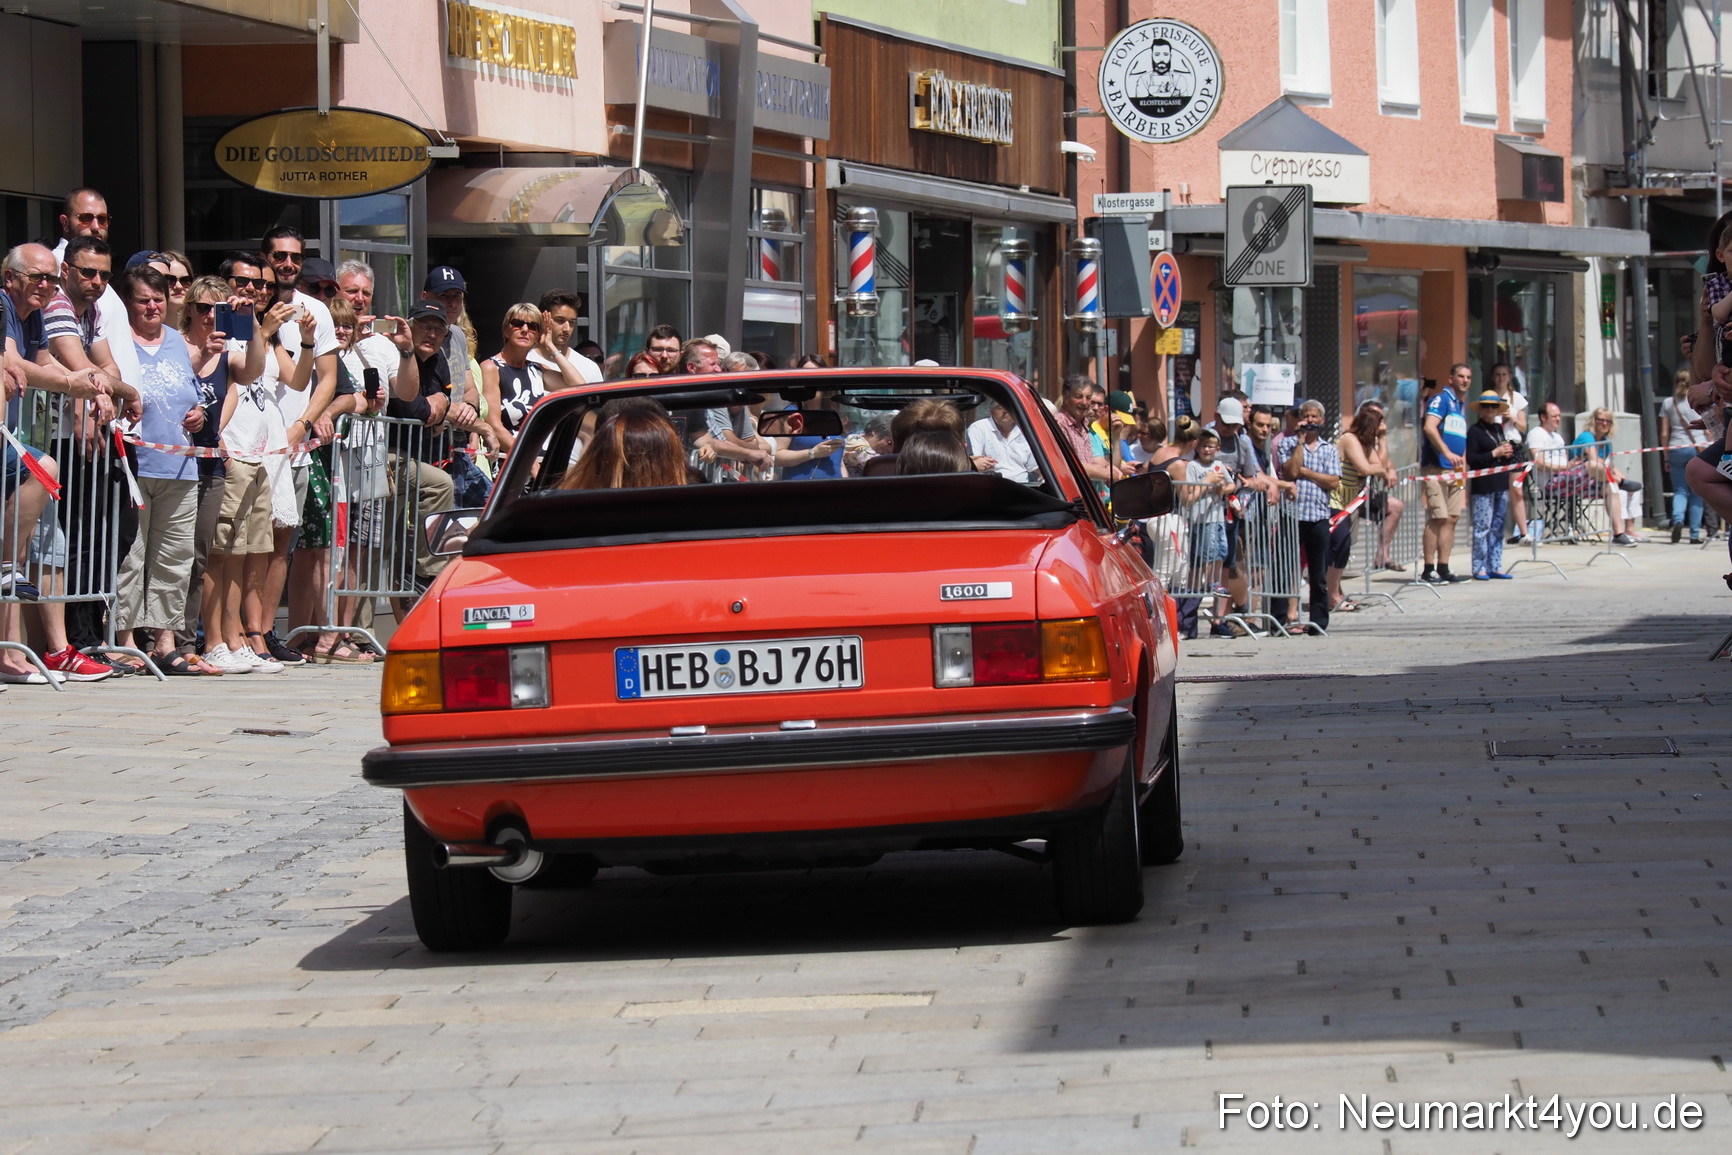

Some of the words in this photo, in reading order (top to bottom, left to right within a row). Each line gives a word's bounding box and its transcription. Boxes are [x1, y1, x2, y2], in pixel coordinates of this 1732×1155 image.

[1111, 29, 1150, 67] FÖN-X
[1152, 26, 1211, 67] FRISEURE
[225, 146, 260, 162] DIE
[265, 146, 426, 163] GOLDSCHMIEDE
[1250, 153, 1342, 184] Creppresso
[280, 171, 316, 182] JUTTA
[319, 171, 368, 181] ROTHER
[1097, 197, 1155, 211] Klostergasse
[1246, 261, 1286, 276] ZONE
[945, 585, 985, 598] 1600
[467, 607, 510, 622] LANCIA
[642, 652, 710, 691] HEB
[738, 648, 783, 686] BJ
[792, 644, 858, 683] 76H
[625, 678, 634, 689] D
